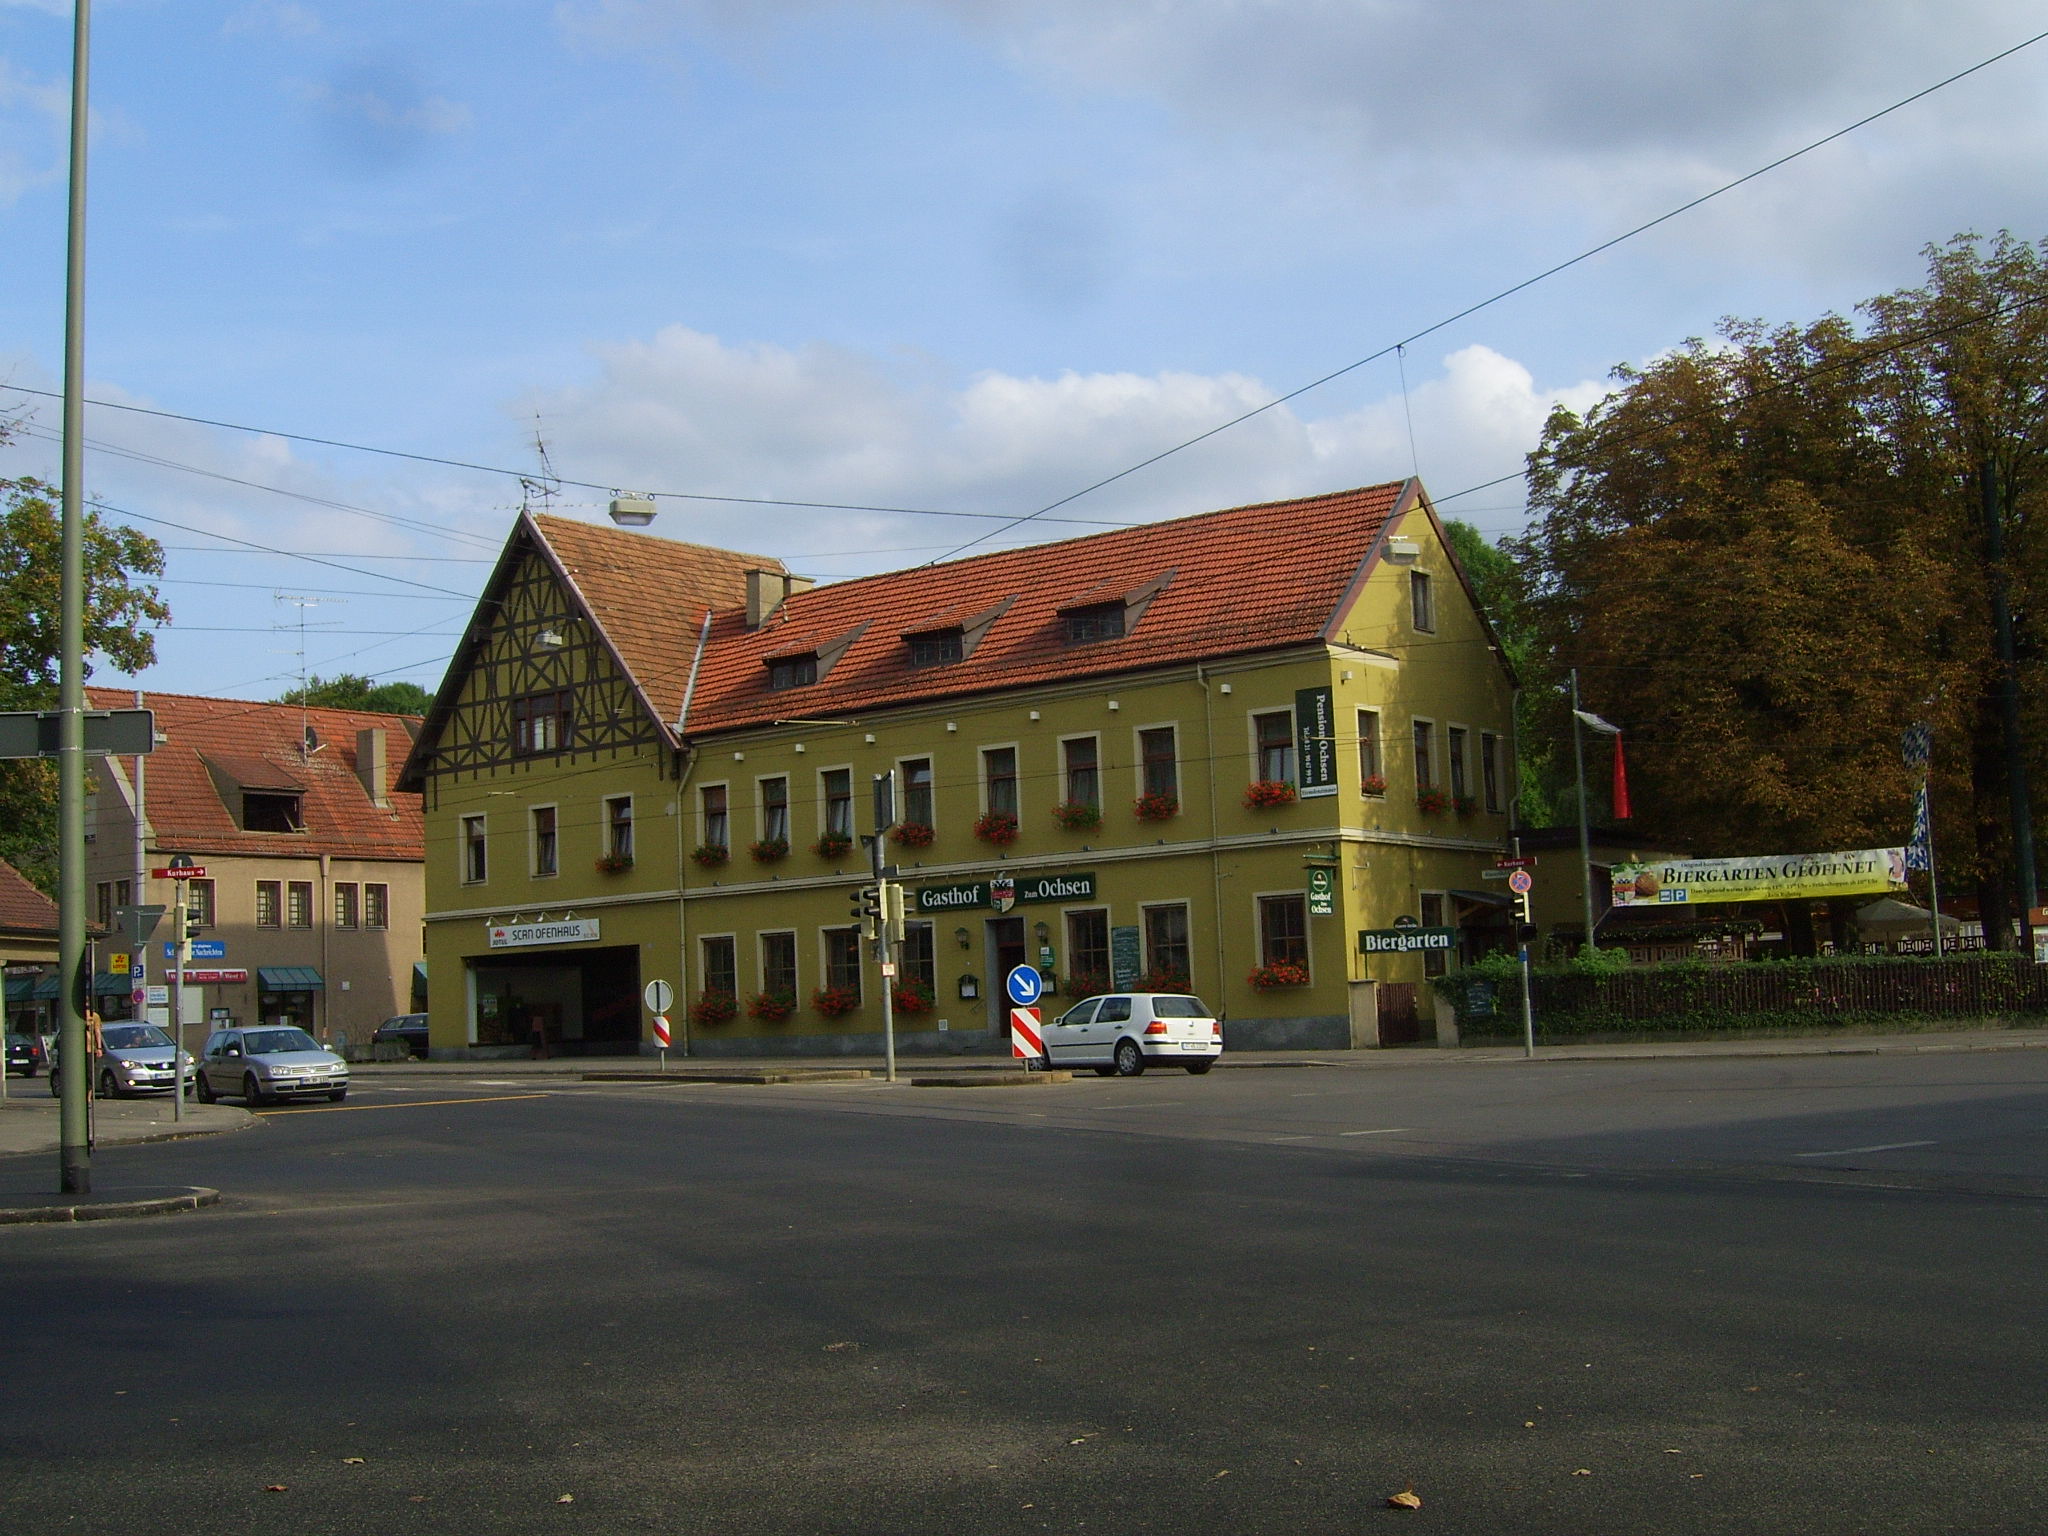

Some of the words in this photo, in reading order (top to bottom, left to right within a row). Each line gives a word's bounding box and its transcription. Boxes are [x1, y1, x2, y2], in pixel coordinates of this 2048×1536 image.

[1316, 694, 1327, 738] Pension
[1319, 740, 1330, 782] Ochsen
[167, 868, 195, 876] Kurhaus
[1663, 867, 1777, 884] BIERGARTEN
[1782, 860, 1876, 879] GEÖFFNET
[922, 885, 980, 907] Gasthof
[1024, 890, 1038, 899] Zum
[1038, 878, 1091, 897] Ochsen
[1310, 892, 1331, 901] Gasthof
[1311, 905, 1332, 914] Ochsen
[512, 929, 534, 941] SCAN
[535, 925, 580, 939] OFENHAUS
[1365, 934, 1449, 952] Biergarten
